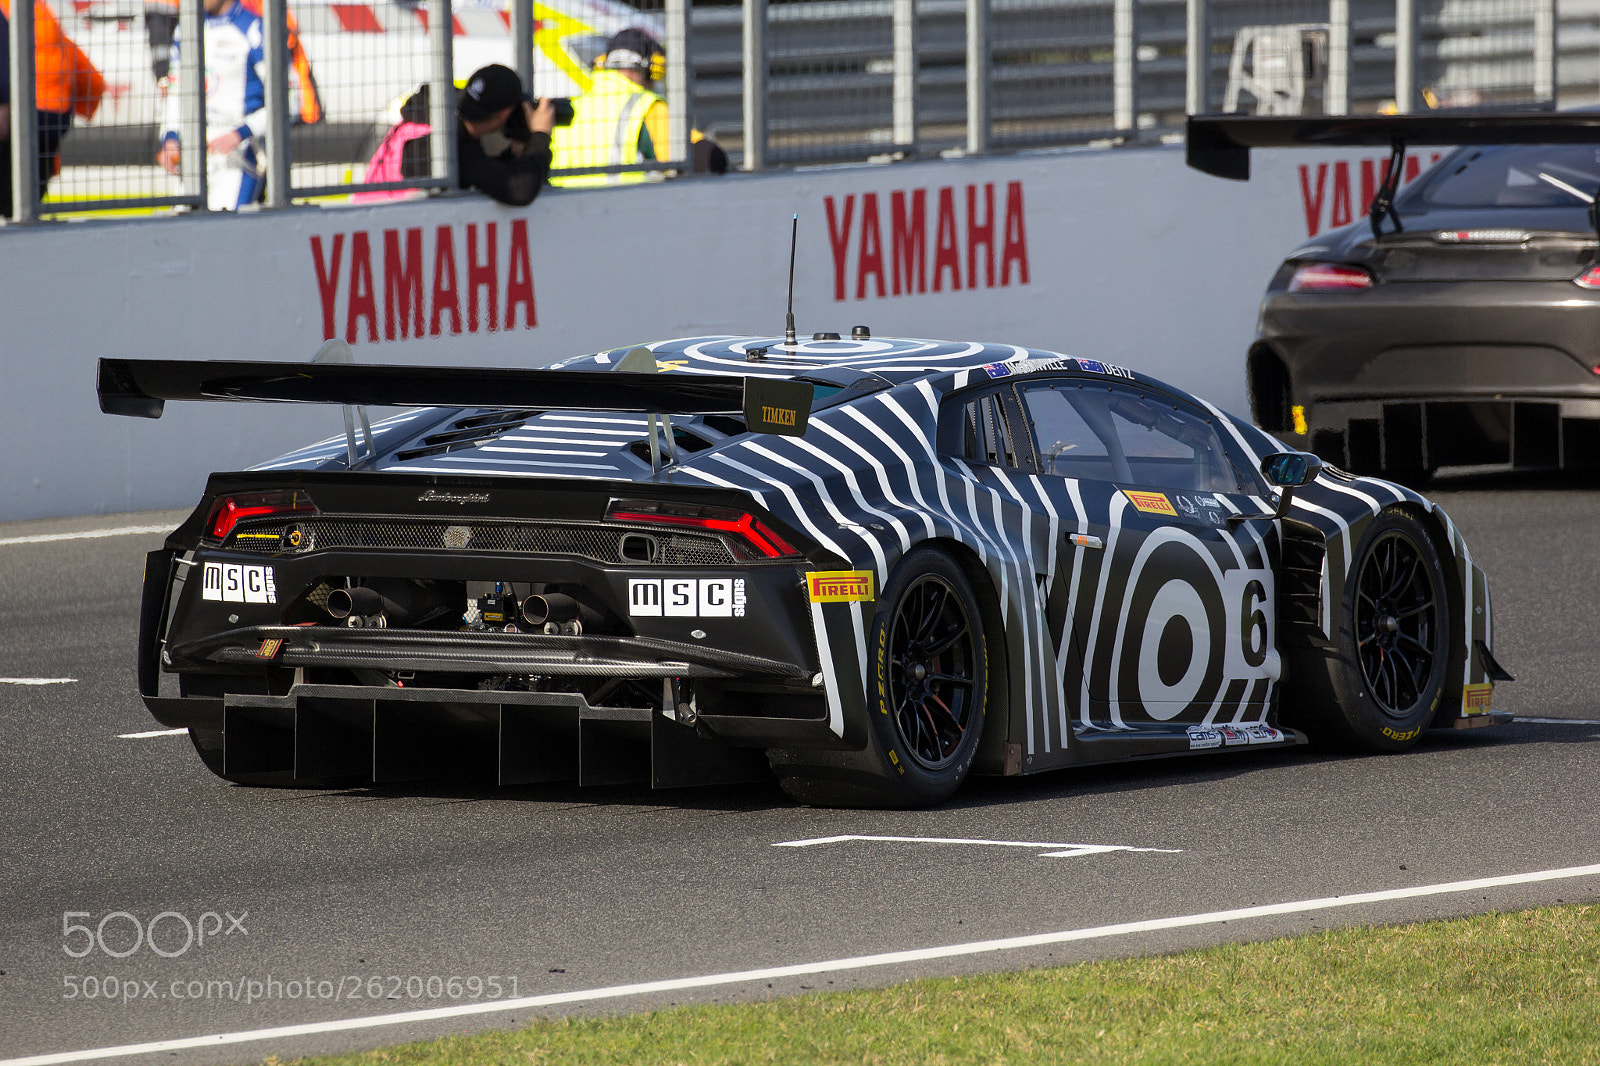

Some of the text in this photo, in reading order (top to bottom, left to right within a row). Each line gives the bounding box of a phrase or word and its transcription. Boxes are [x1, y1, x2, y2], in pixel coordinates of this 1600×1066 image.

[823, 180, 1031, 301] YAMAHA
[310, 219, 537, 344] YAMAHA
[1103, 362, 1136, 380] DEITZ
[761, 406, 796, 427] TIMKEN
[1130, 494, 1172, 511] PIRELLI
[732, 578, 747, 617] signs
[812, 576, 869, 597] PIRELLI
[1241, 579, 1268, 668] 6
